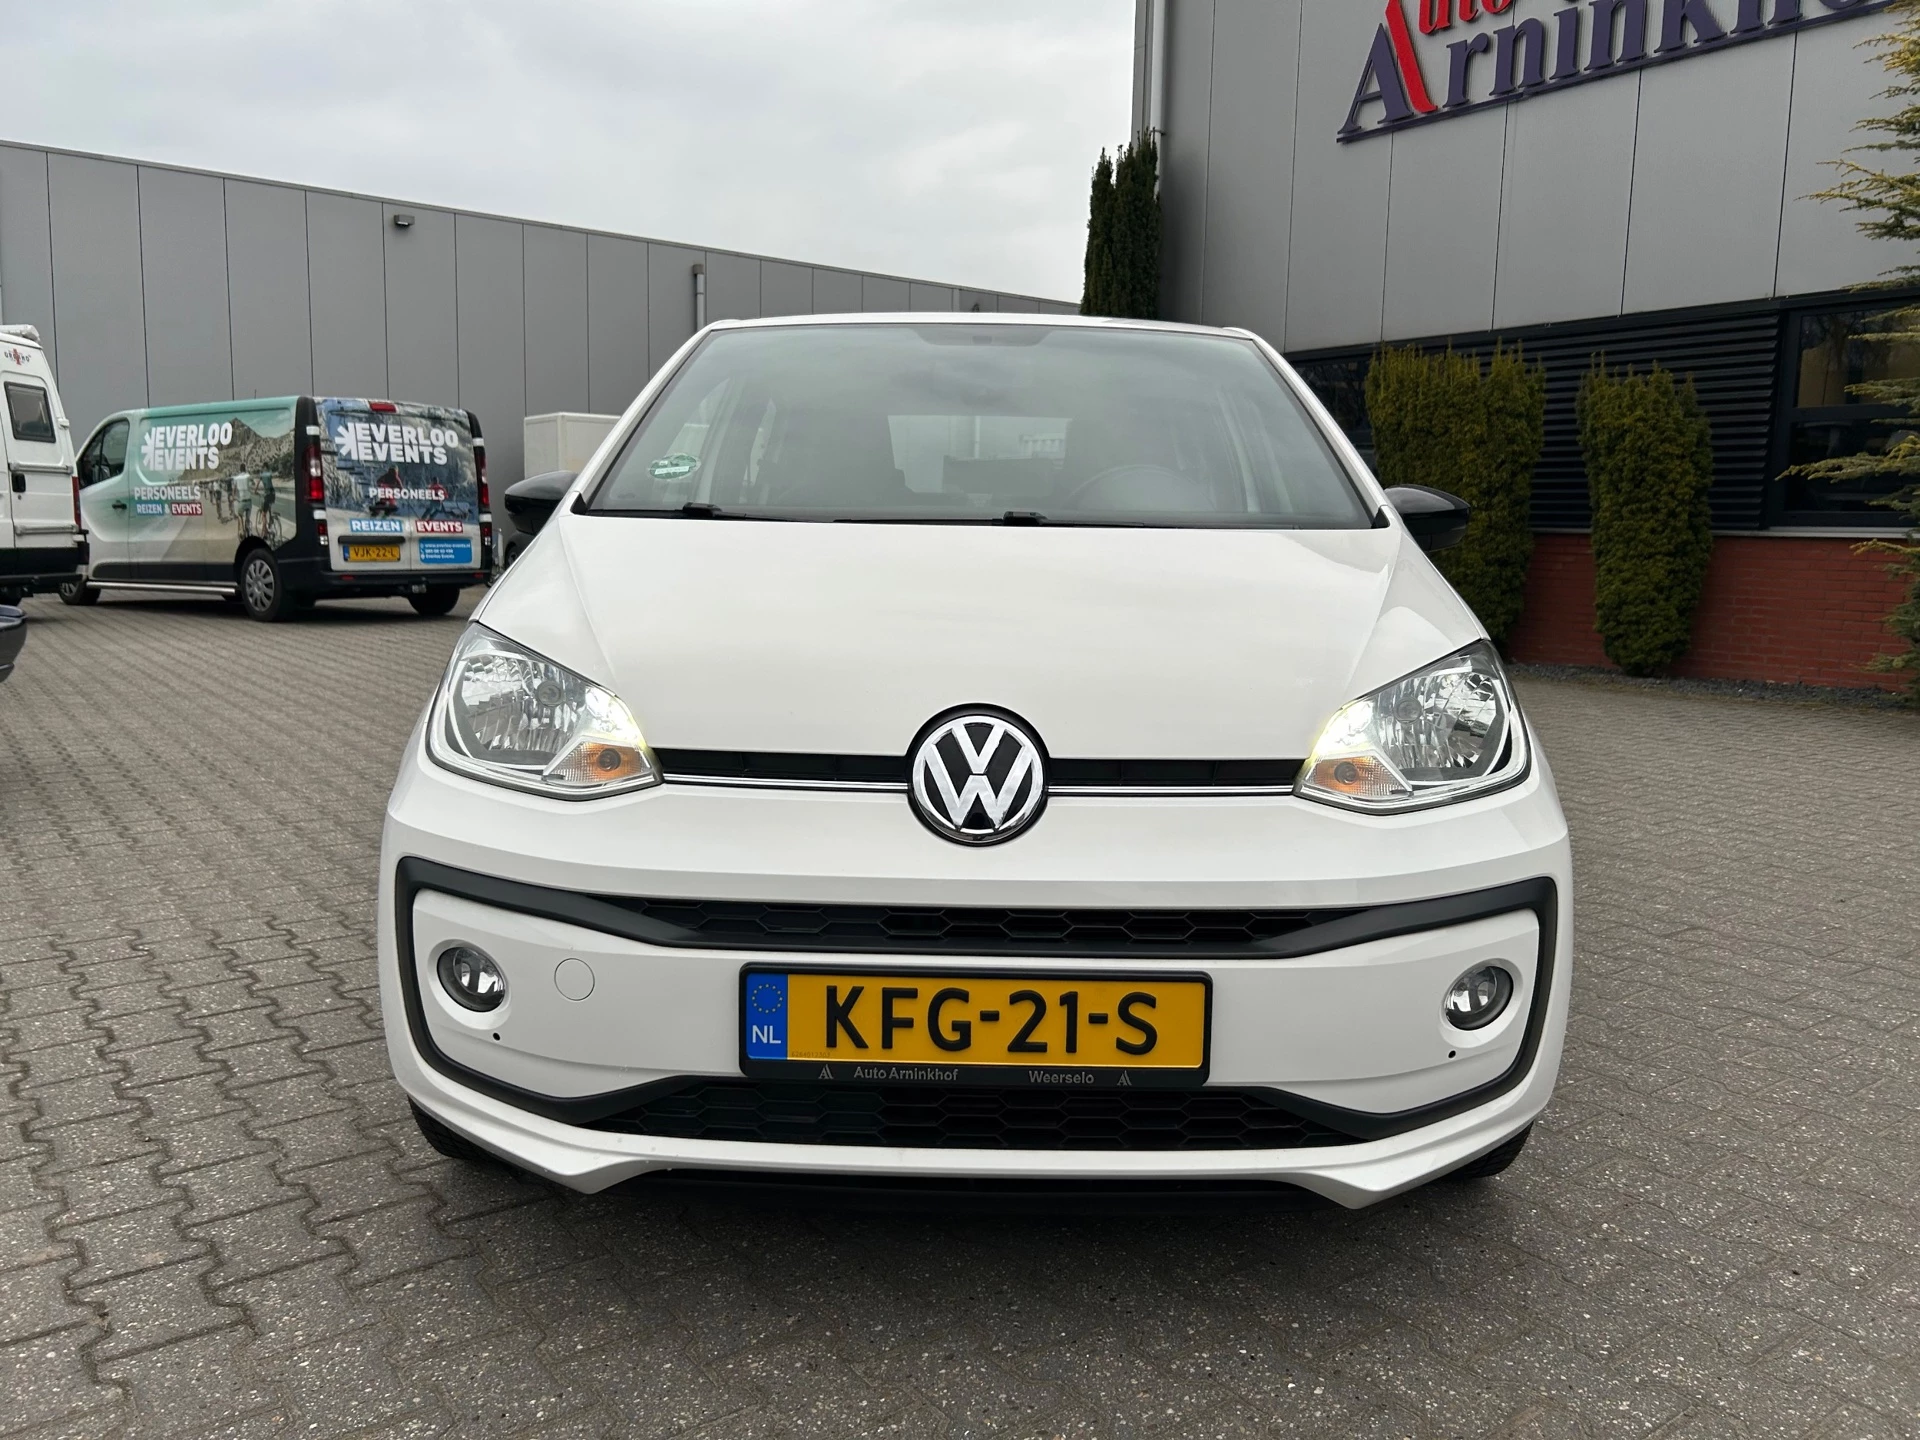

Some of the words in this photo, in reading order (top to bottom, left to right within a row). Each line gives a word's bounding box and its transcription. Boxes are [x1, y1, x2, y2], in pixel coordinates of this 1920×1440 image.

[155, 422, 233, 448] EVERLOO
[355, 422, 459, 448] EVERLOO
[154, 447, 219, 471] EVENTS
[357, 442, 448, 465] EVENTS
[134, 486, 201, 501] PERSONEELS
[368, 487, 445, 501] PERSONEELS
[136, 503, 163, 514] REIZEN
[171, 503, 202, 514] EVENTS
[351, 520, 400, 532] REIZEN
[417, 521, 462, 532] EVENTS
[353, 546, 398, 558] VJK-22-L
[825, 985, 1158, 1056] KFG-21-S
[752, 1025, 782, 1044] NL
[853, 1066, 887, 1080] Auto
[889, 1066, 958, 1081] Arninkhof
[1029, 1070, 1095, 1084] Weerselo
